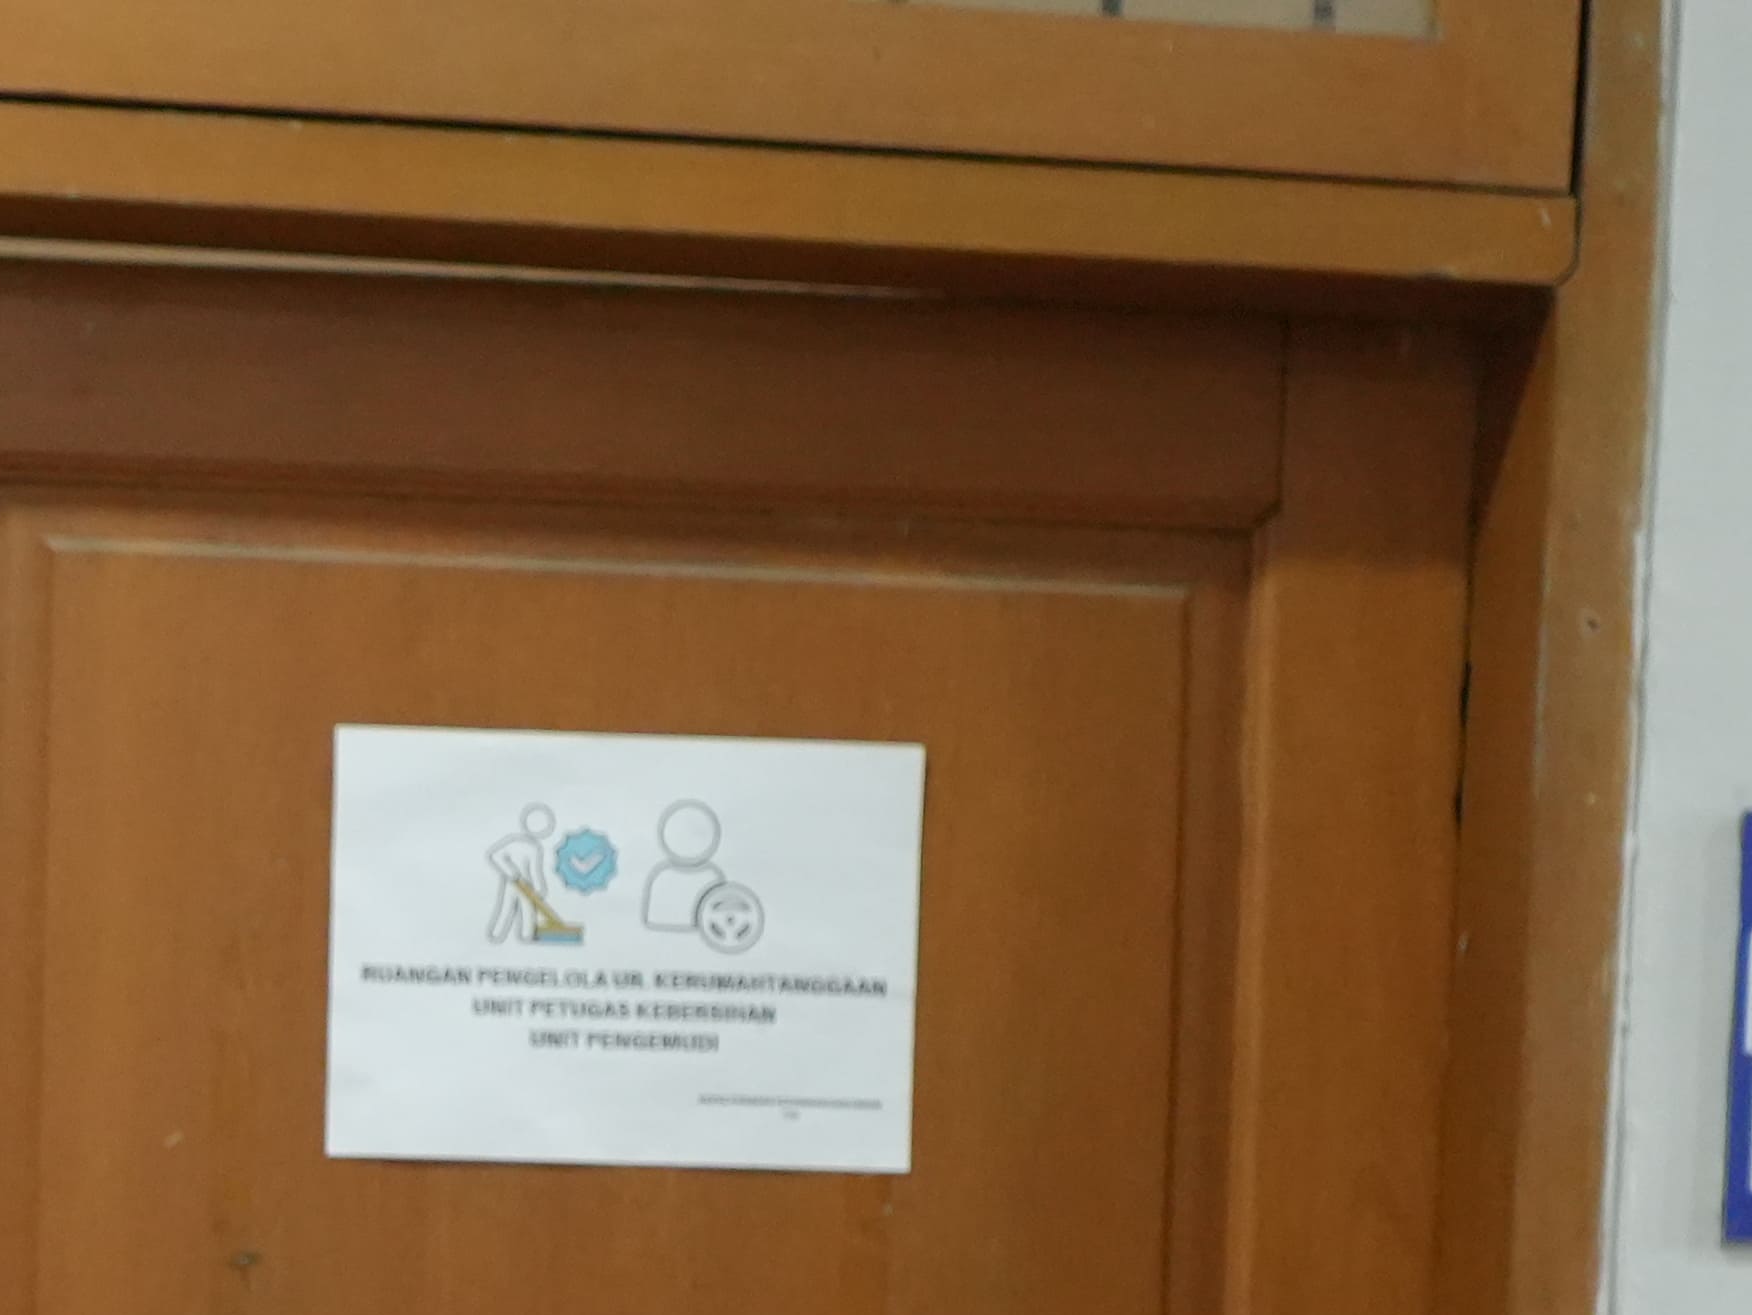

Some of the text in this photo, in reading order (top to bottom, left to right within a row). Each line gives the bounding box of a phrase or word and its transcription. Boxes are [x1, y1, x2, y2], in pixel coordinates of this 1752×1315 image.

[362, 963, 472, 985] RUANGAN
[472, 998, 523, 1015] UNIT
[529, 999, 630, 1019] PETUGAS
[529, 1029, 579, 1047] UNIT
